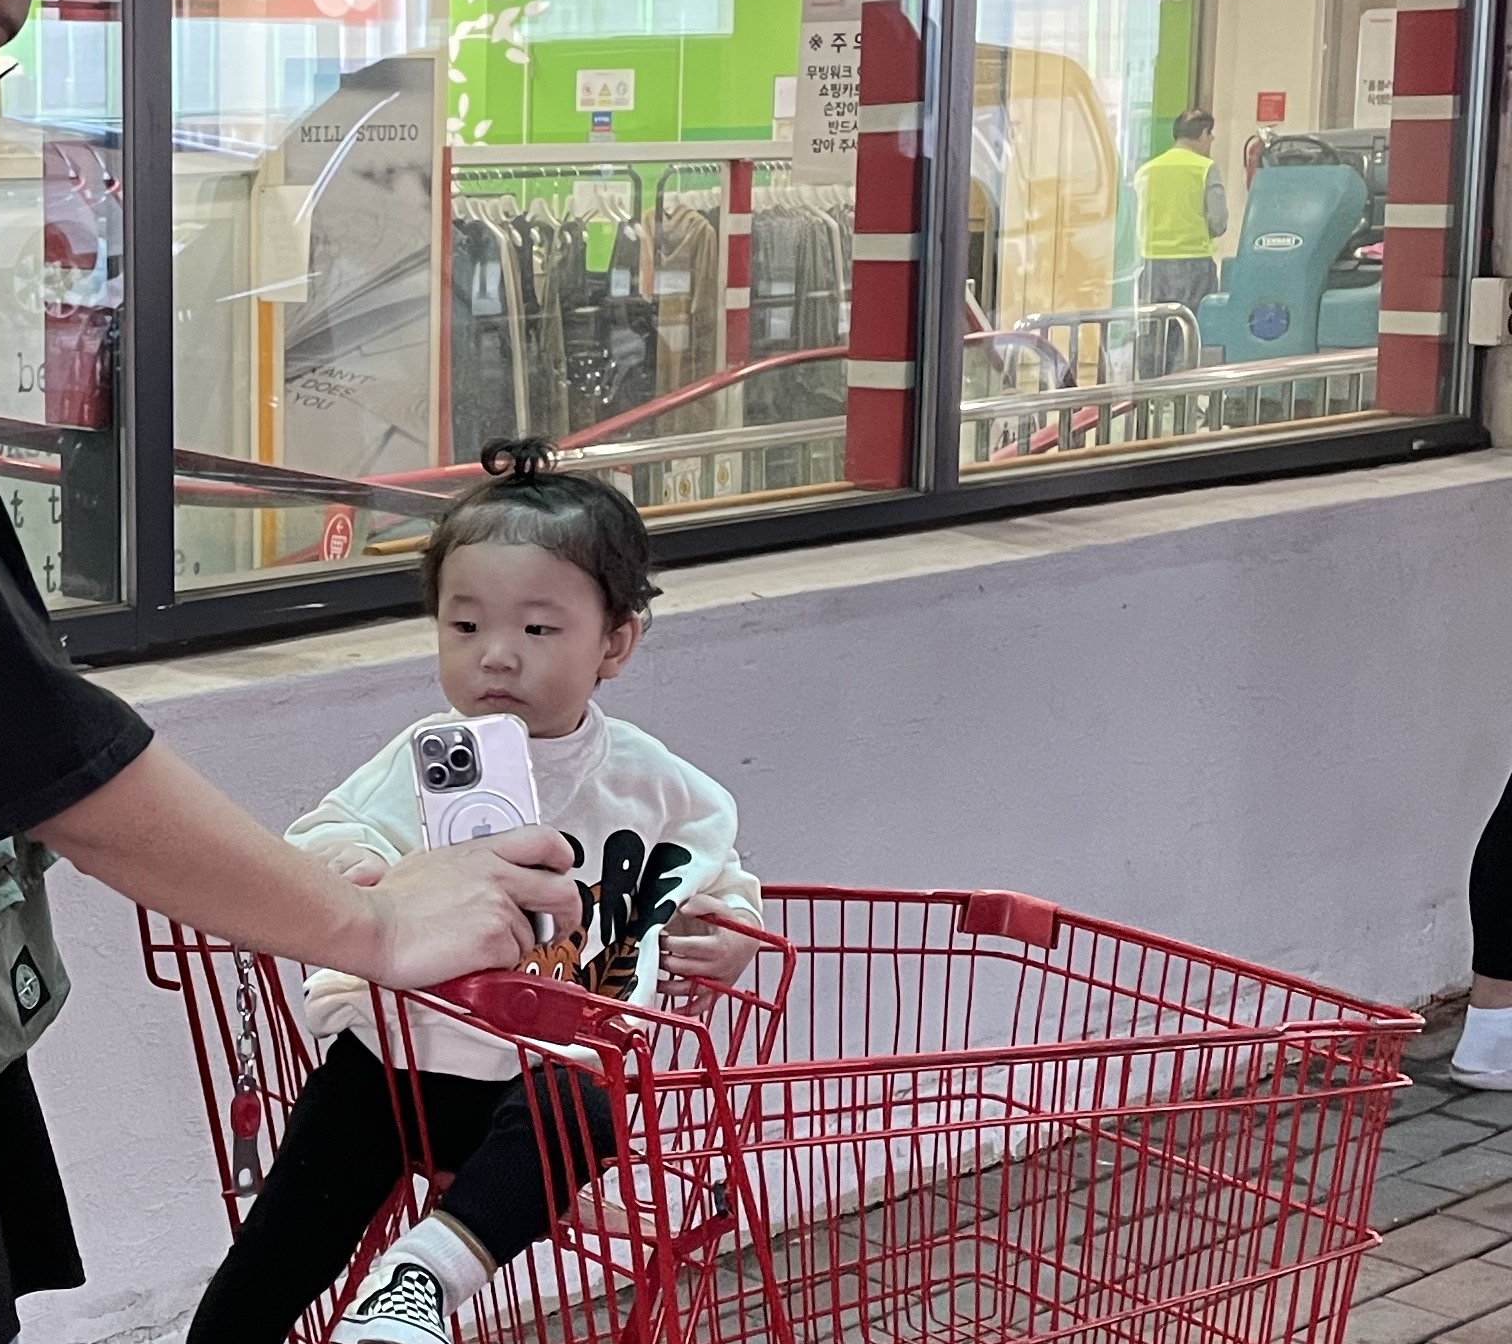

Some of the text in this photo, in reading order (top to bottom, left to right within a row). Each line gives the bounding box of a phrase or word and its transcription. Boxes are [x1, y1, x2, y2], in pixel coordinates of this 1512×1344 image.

[806, 65, 853, 80] 무빙워크
[300, 124, 419, 143] MILL STUDIO
[810, 138, 835, 153] 잡아
[301, 378, 356, 396] DOES
[293, 392, 336, 410] YOU
